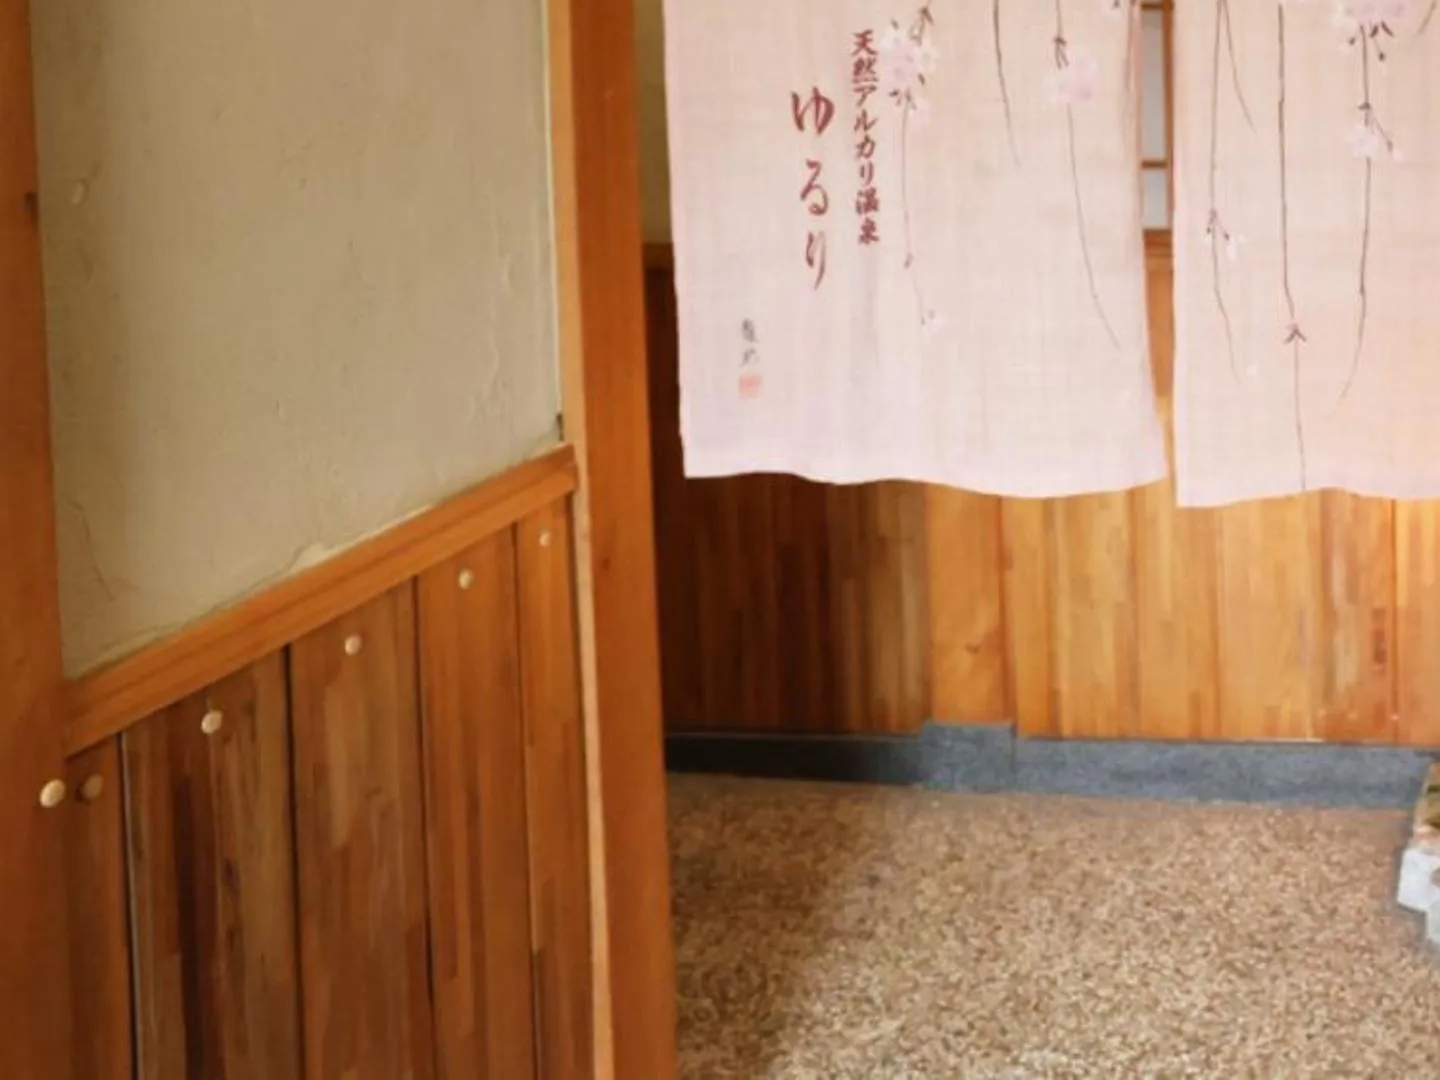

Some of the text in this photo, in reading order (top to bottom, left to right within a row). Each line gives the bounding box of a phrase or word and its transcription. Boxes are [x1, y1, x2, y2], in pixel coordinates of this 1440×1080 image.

[790, 86, 836, 291] ゆるり
[851, 29, 881, 245] 天然アルカリ温泉
